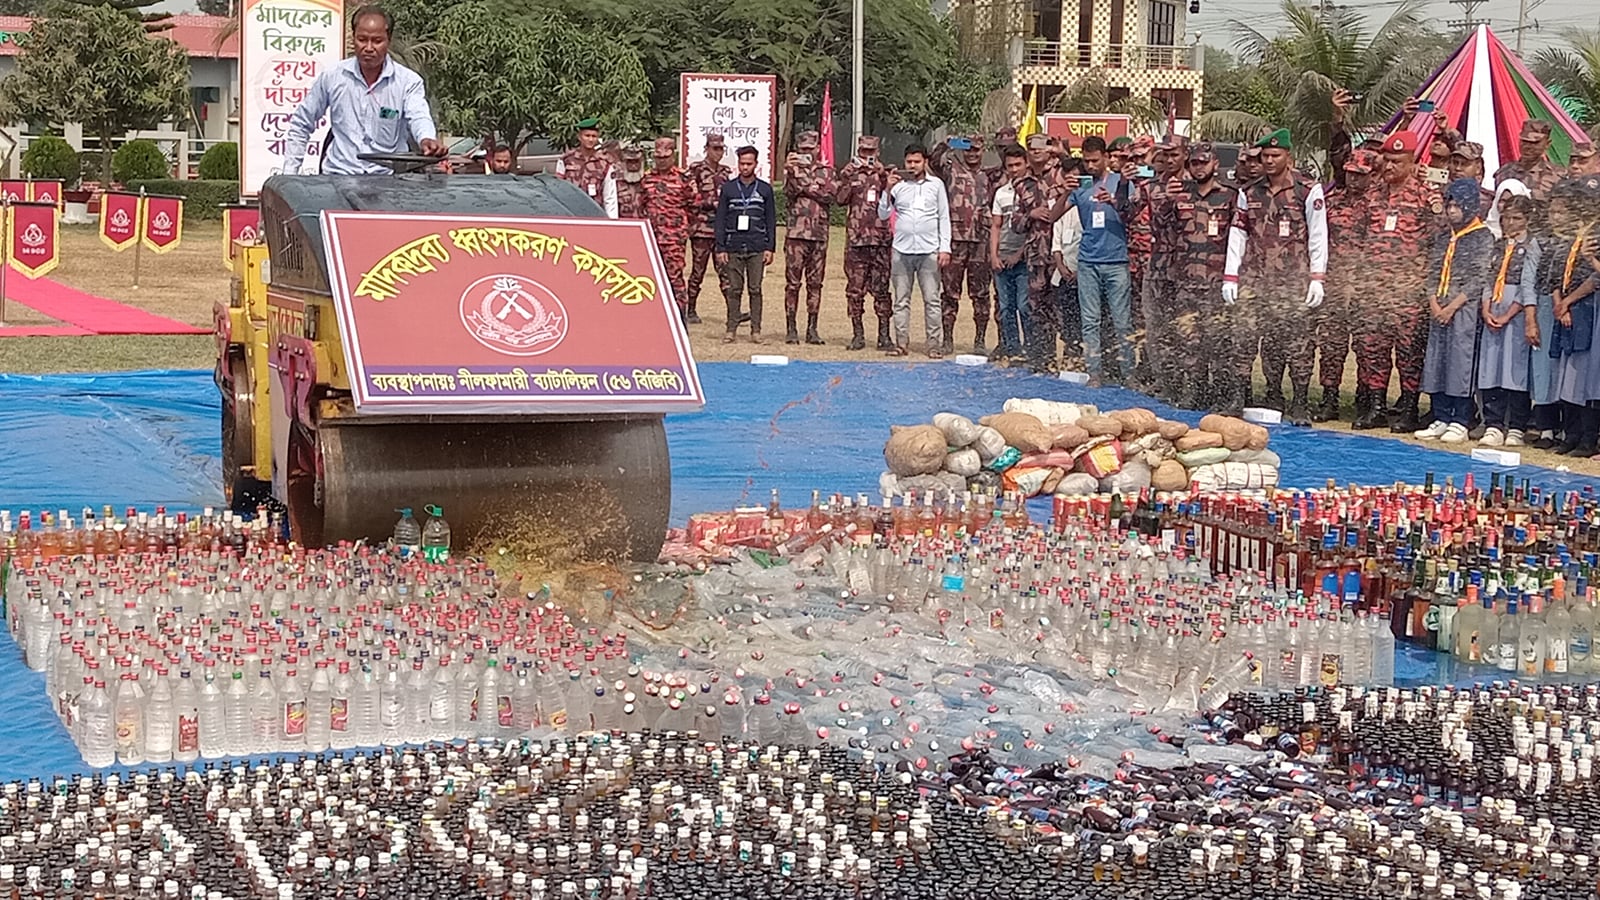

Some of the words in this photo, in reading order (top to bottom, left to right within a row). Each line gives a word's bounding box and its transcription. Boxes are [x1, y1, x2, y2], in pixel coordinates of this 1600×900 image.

[256, 4, 332, 28] মাদকের
[263, 29, 325, 56] বিরুদ্ধে
[272, 60, 316, 80] রুখে
[264, 79, 311, 108] দাঁড়া
[702, 87, 757, 104] মাদক
[740, 108, 748, 119] ও
[1067, 120, 1109, 138] আসন
[353, 234, 450, 301] মাদকদ্রব্য
[448, 226, 569, 265] ধ্বংসকরণ
[572, 245, 657, 304] কর্মসূচি
[369, 372, 456, 395] ব্যবস্থাপনায়ঃ
[457, 367, 530, 391] নীলফামারী
[531, 368, 600, 391] ব্যাটালিয়ন
[602, 371, 632, 394] (৫৬
[632, 368, 685, 394] বিজিবি)
